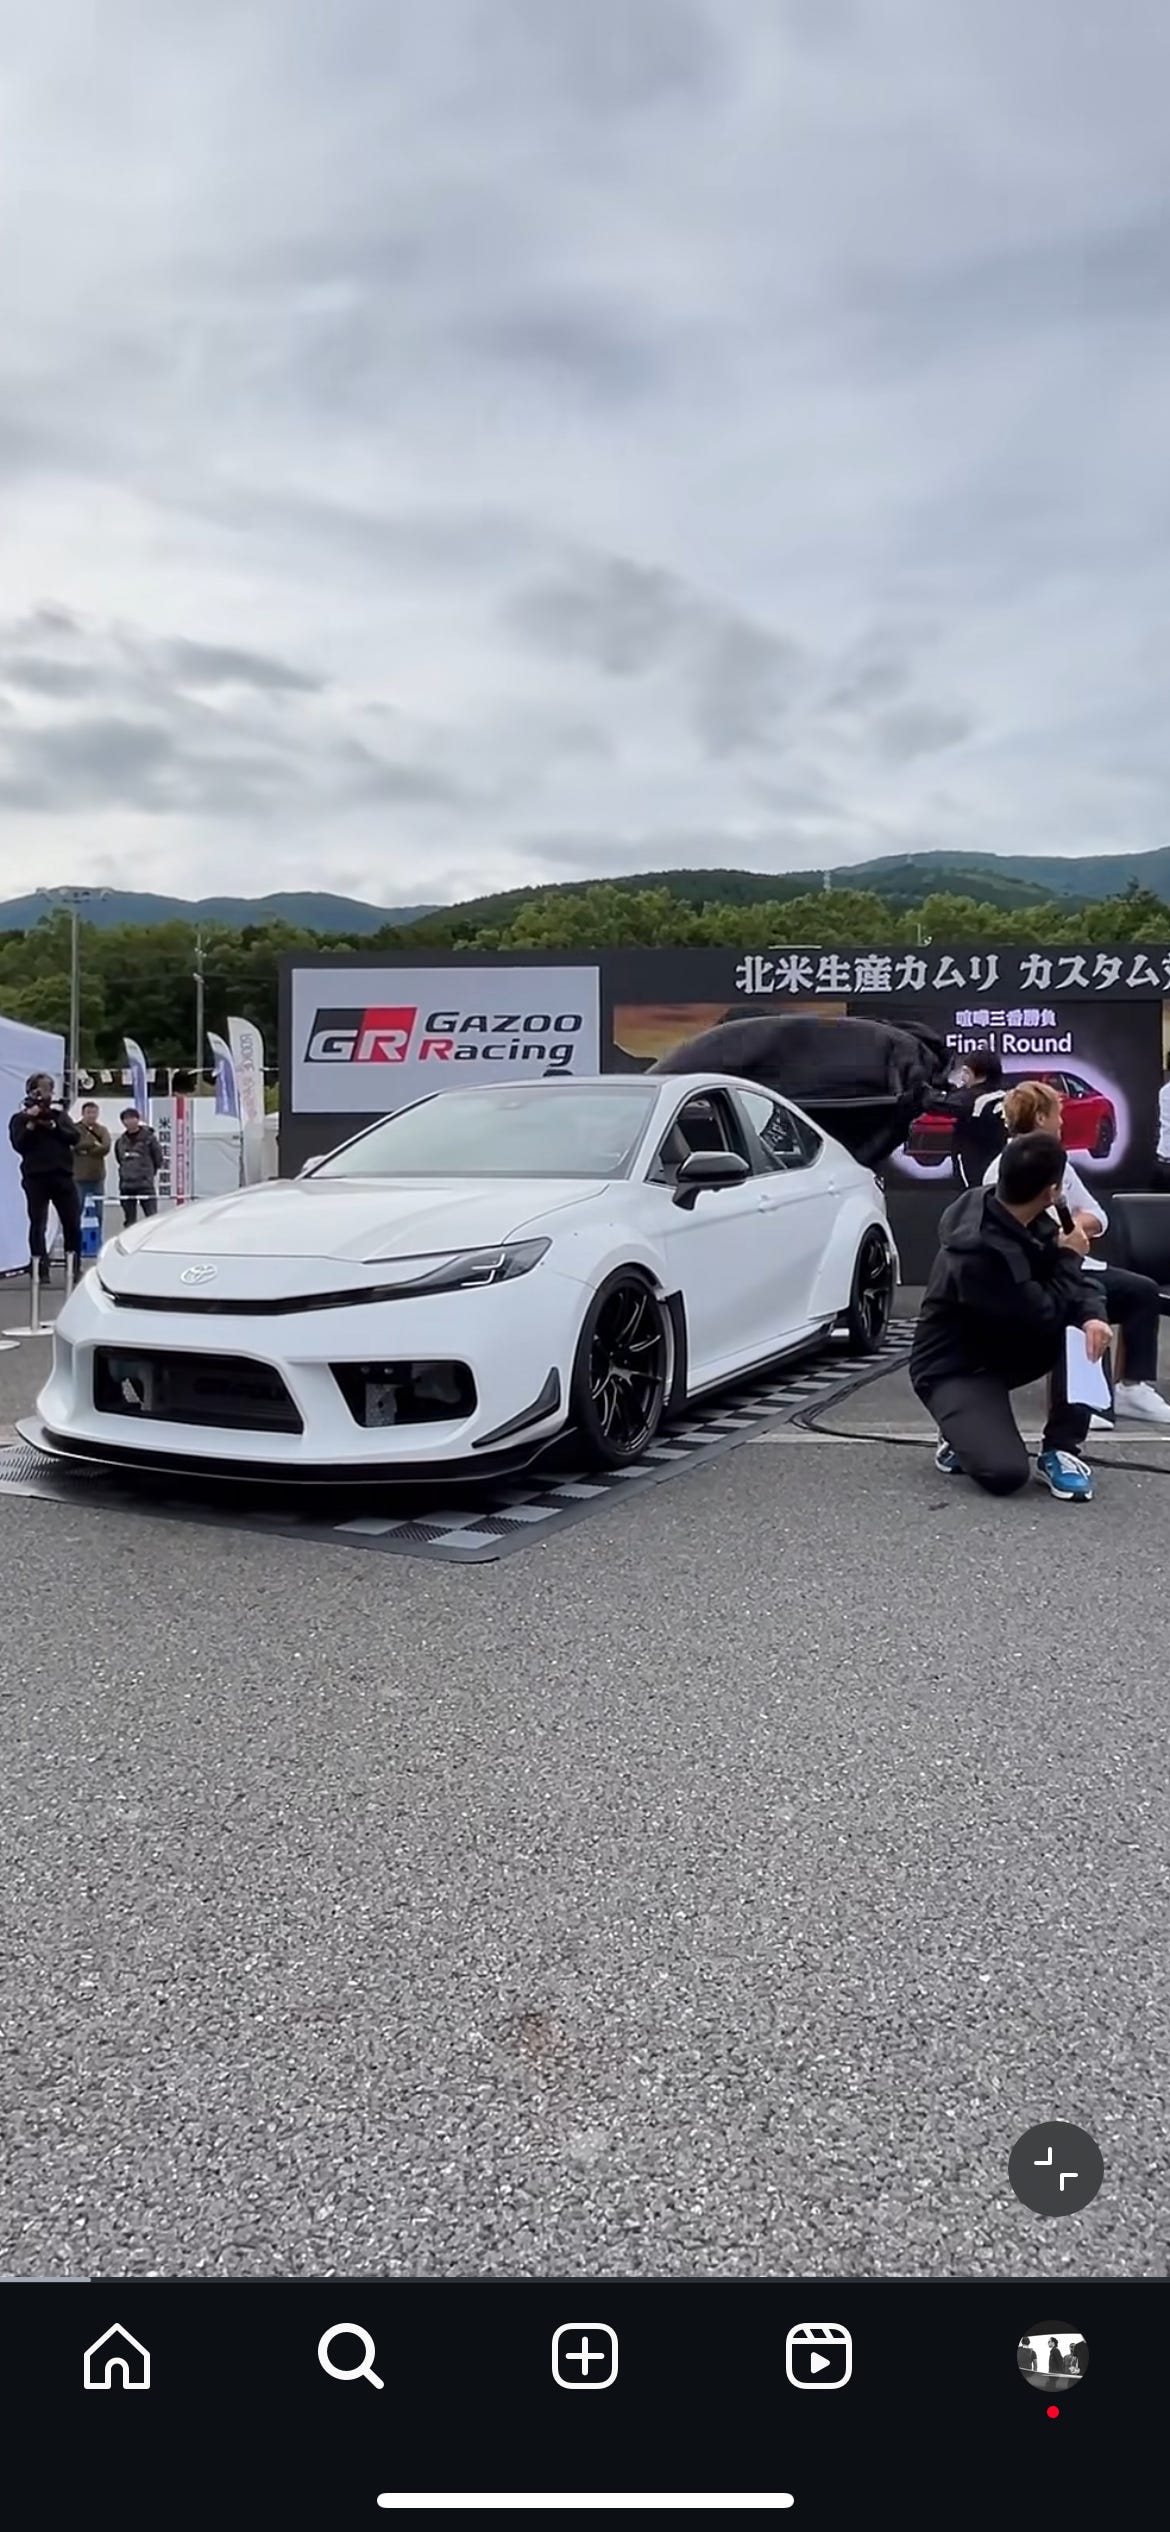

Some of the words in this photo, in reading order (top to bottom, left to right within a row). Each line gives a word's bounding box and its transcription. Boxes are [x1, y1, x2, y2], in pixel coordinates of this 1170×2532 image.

[735, 953, 1000, 994] 北米生産カムリ
[425, 1011, 583, 1033] GAZOO
[308, 1029, 408, 1062] GR
[418, 1038, 574, 1067] Racing
[1003, 1032, 1072, 1053] Round
